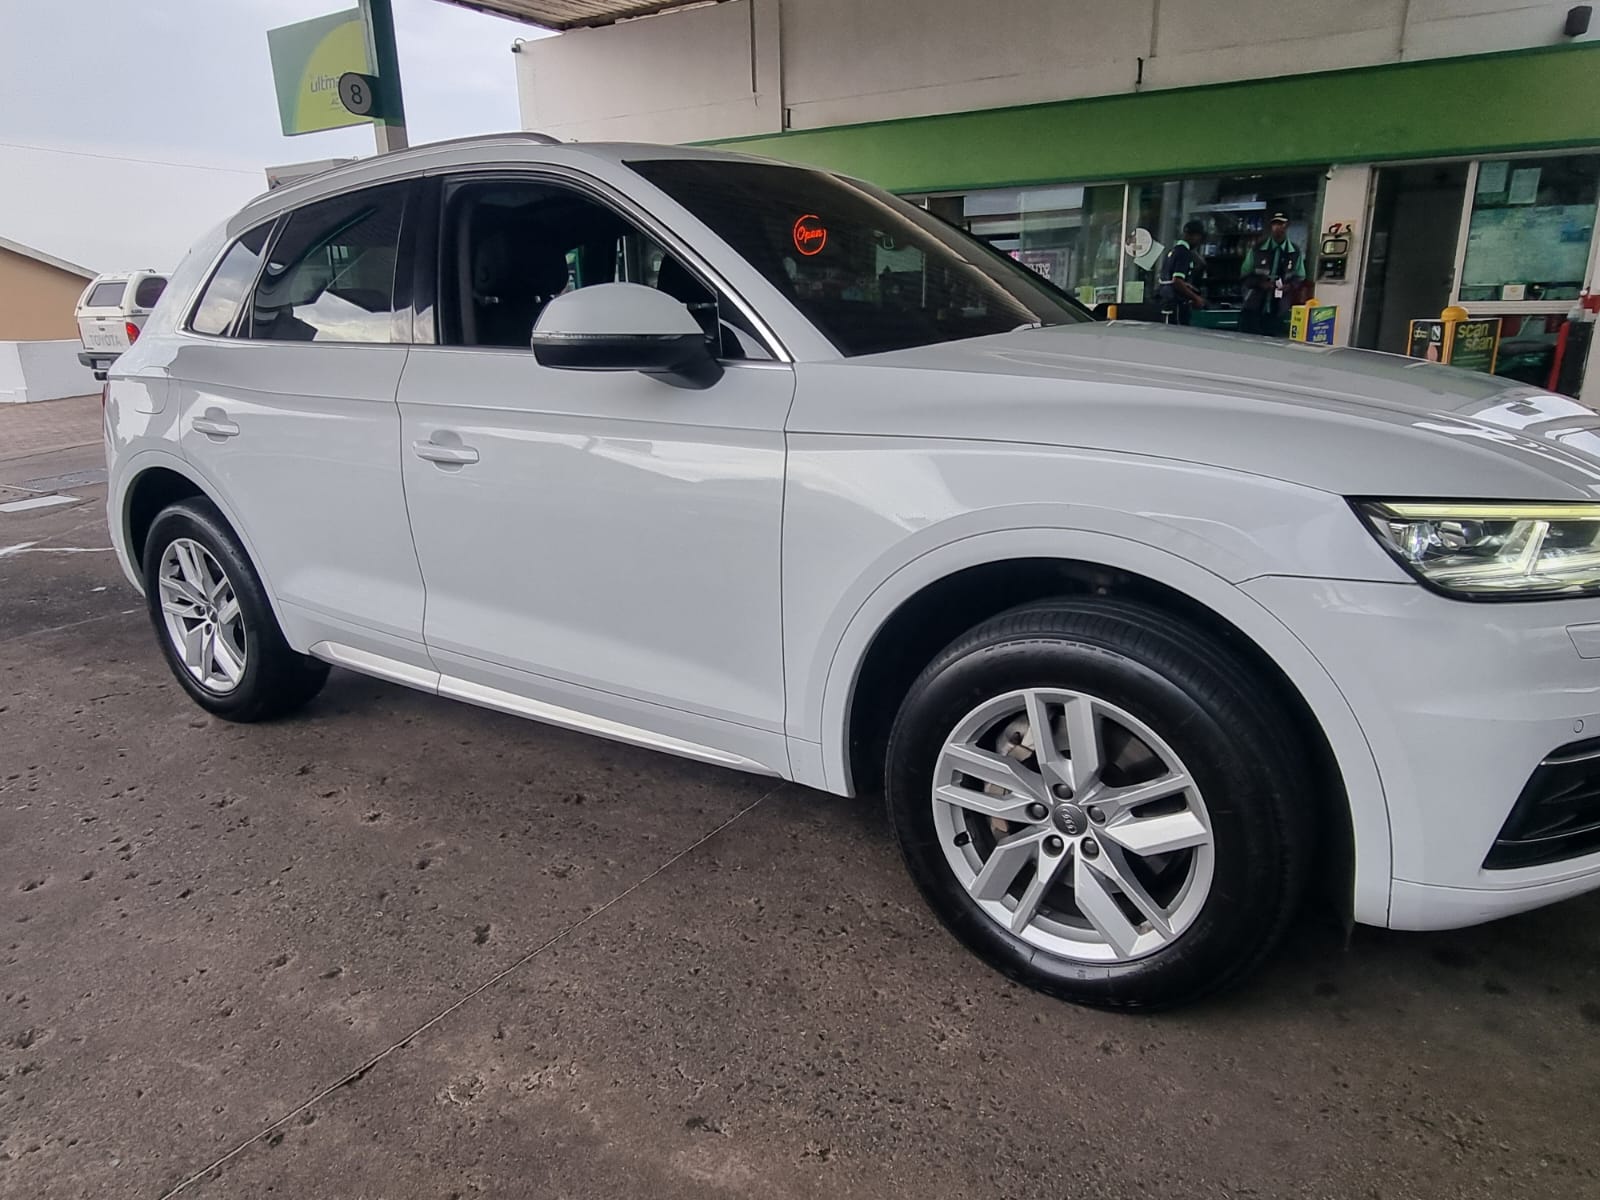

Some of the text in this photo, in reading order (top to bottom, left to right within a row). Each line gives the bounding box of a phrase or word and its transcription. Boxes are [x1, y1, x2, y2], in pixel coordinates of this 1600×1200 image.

[350, 83, 363, 105] 8
[796, 226, 824, 244] Open
[1457, 323, 1489, 338] scan
[89, 334, 122, 347] TOYOTA
[1463, 336, 1494, 351] scan
